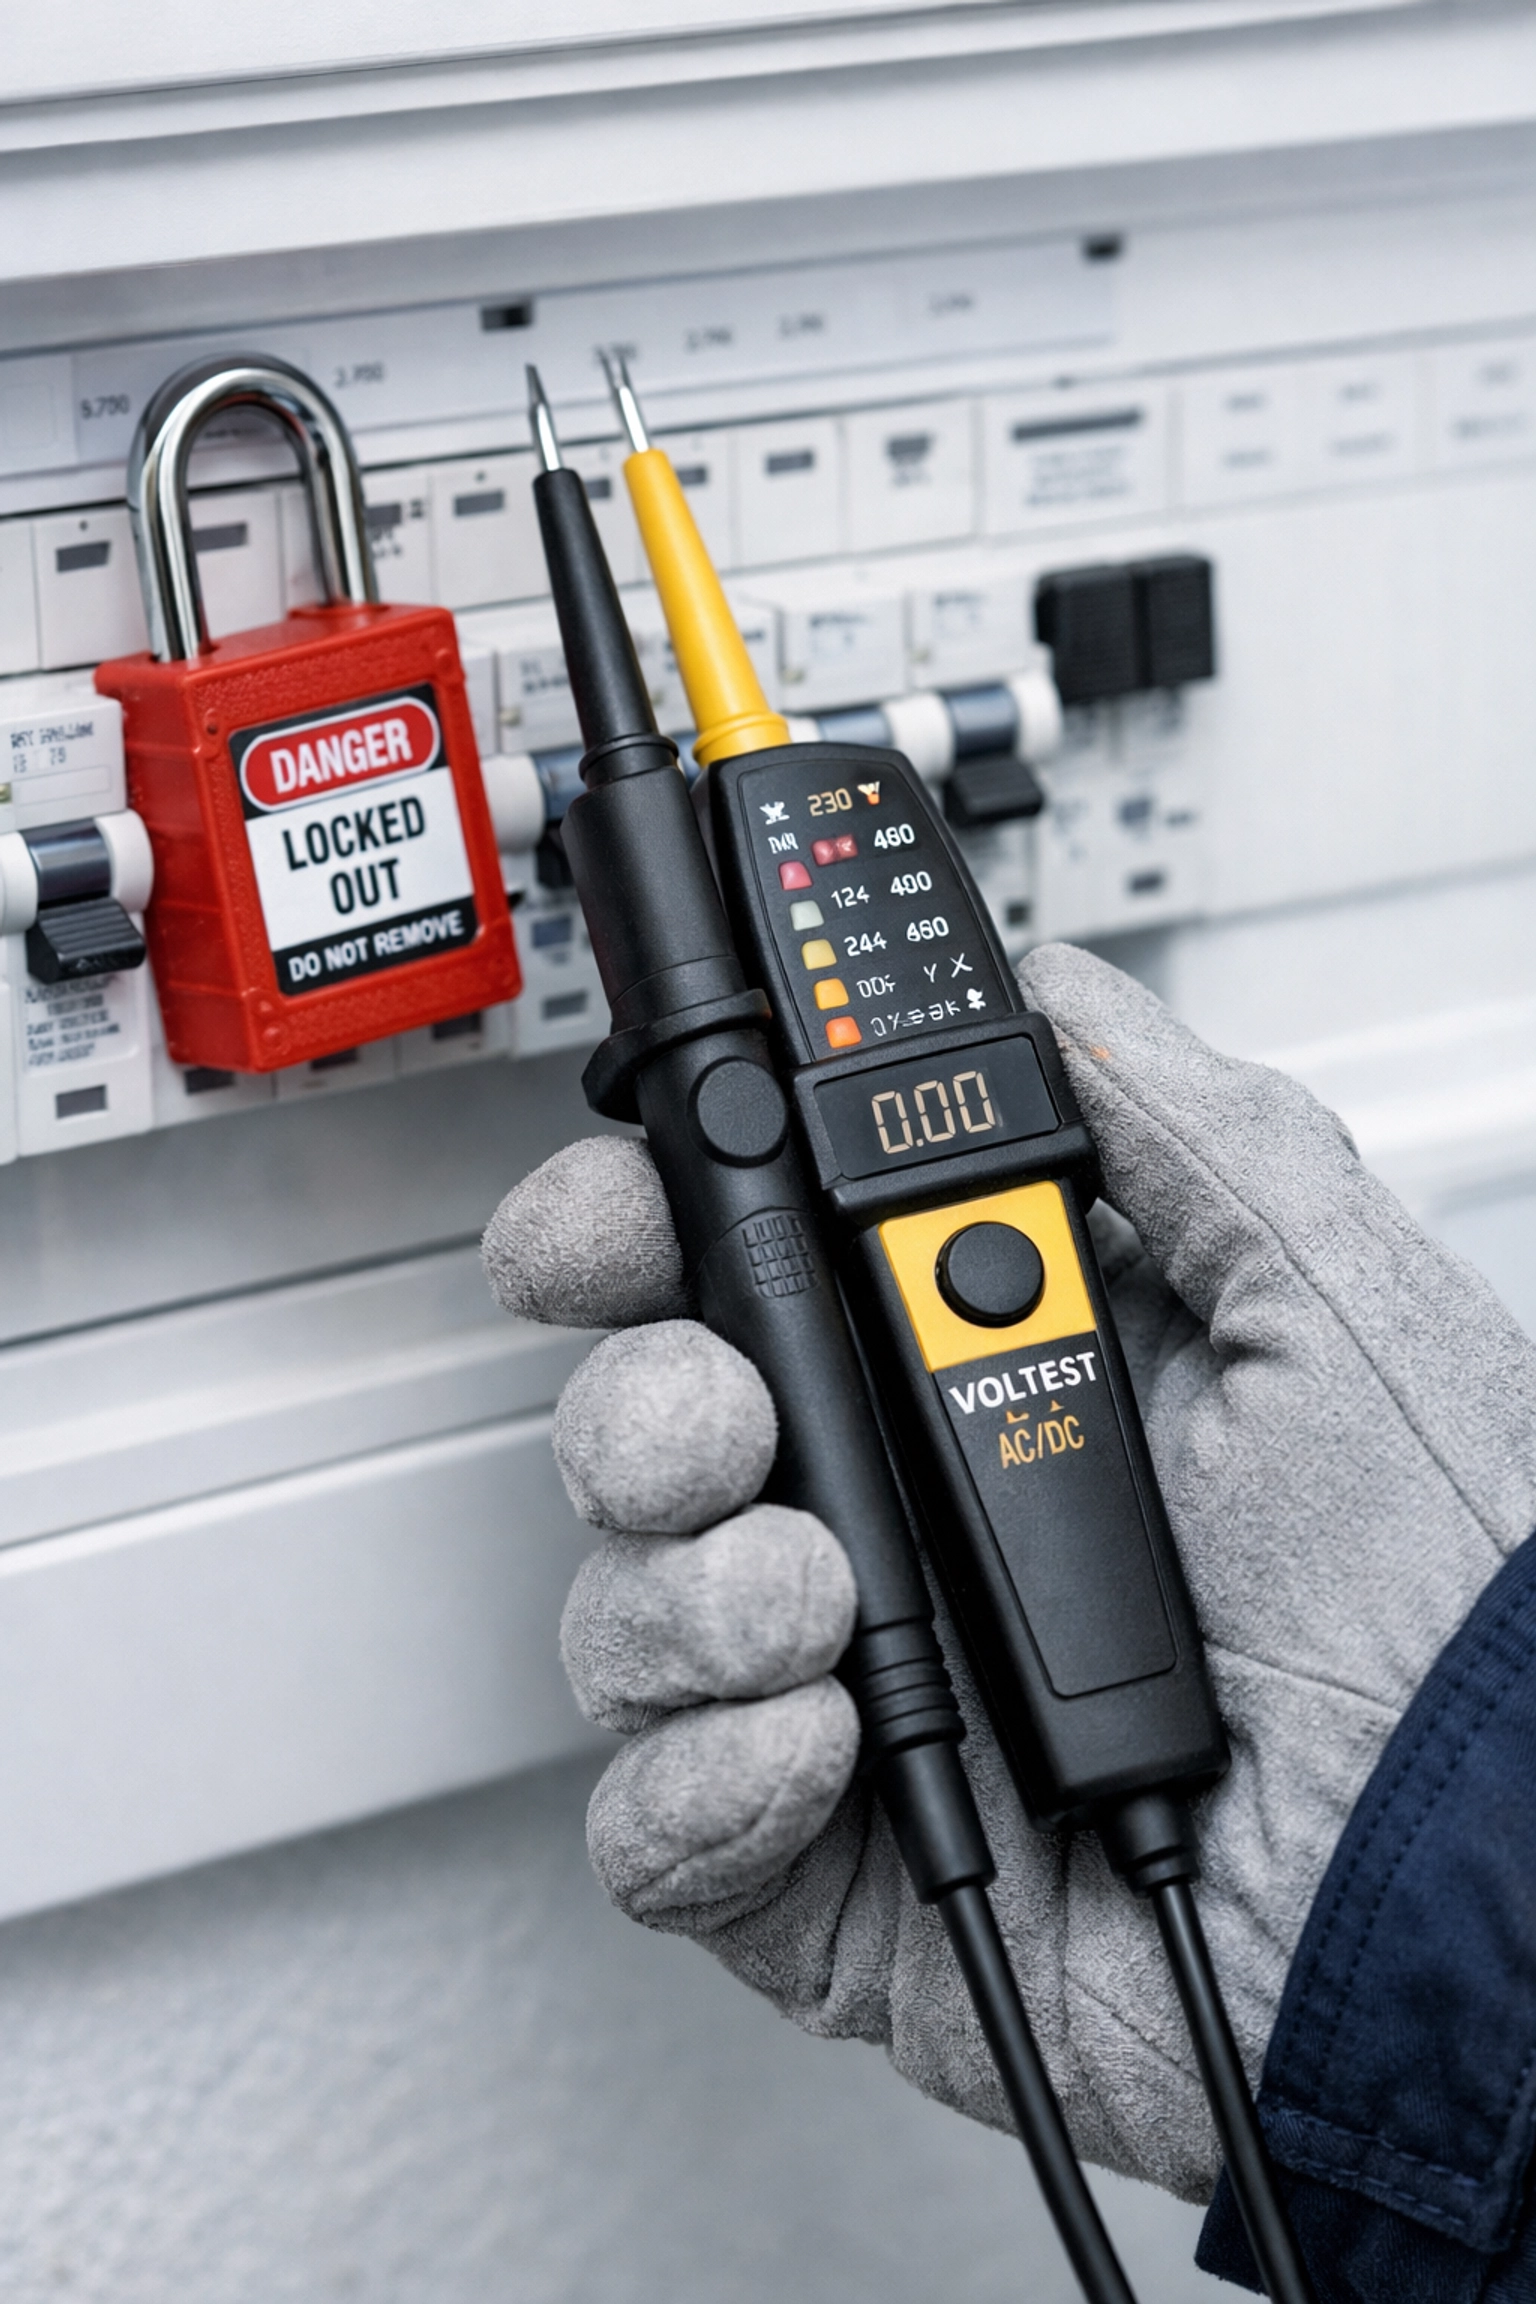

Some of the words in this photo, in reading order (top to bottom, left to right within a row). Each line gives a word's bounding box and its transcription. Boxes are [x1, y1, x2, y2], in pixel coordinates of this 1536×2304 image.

[269, 717, 414, 795] DANGER
[807, 787, 854, 817] 230
[281, 795, 427, 872] LOCKED
[329, 857, 400, 916] OUT
[830, 884, 871, 910] 124
[287, 951, 323, 983] DO
[324, 936, 369, 972] NOT
[373, 909, 465, 957] REMOVE
[843, 931, 888, 957] 244
[871, 1069, 998, 1156] 0.00
[947, 1350, 1098, 1416] VOLTEST
[998, 1414, 1086, 1470] AC/DC
